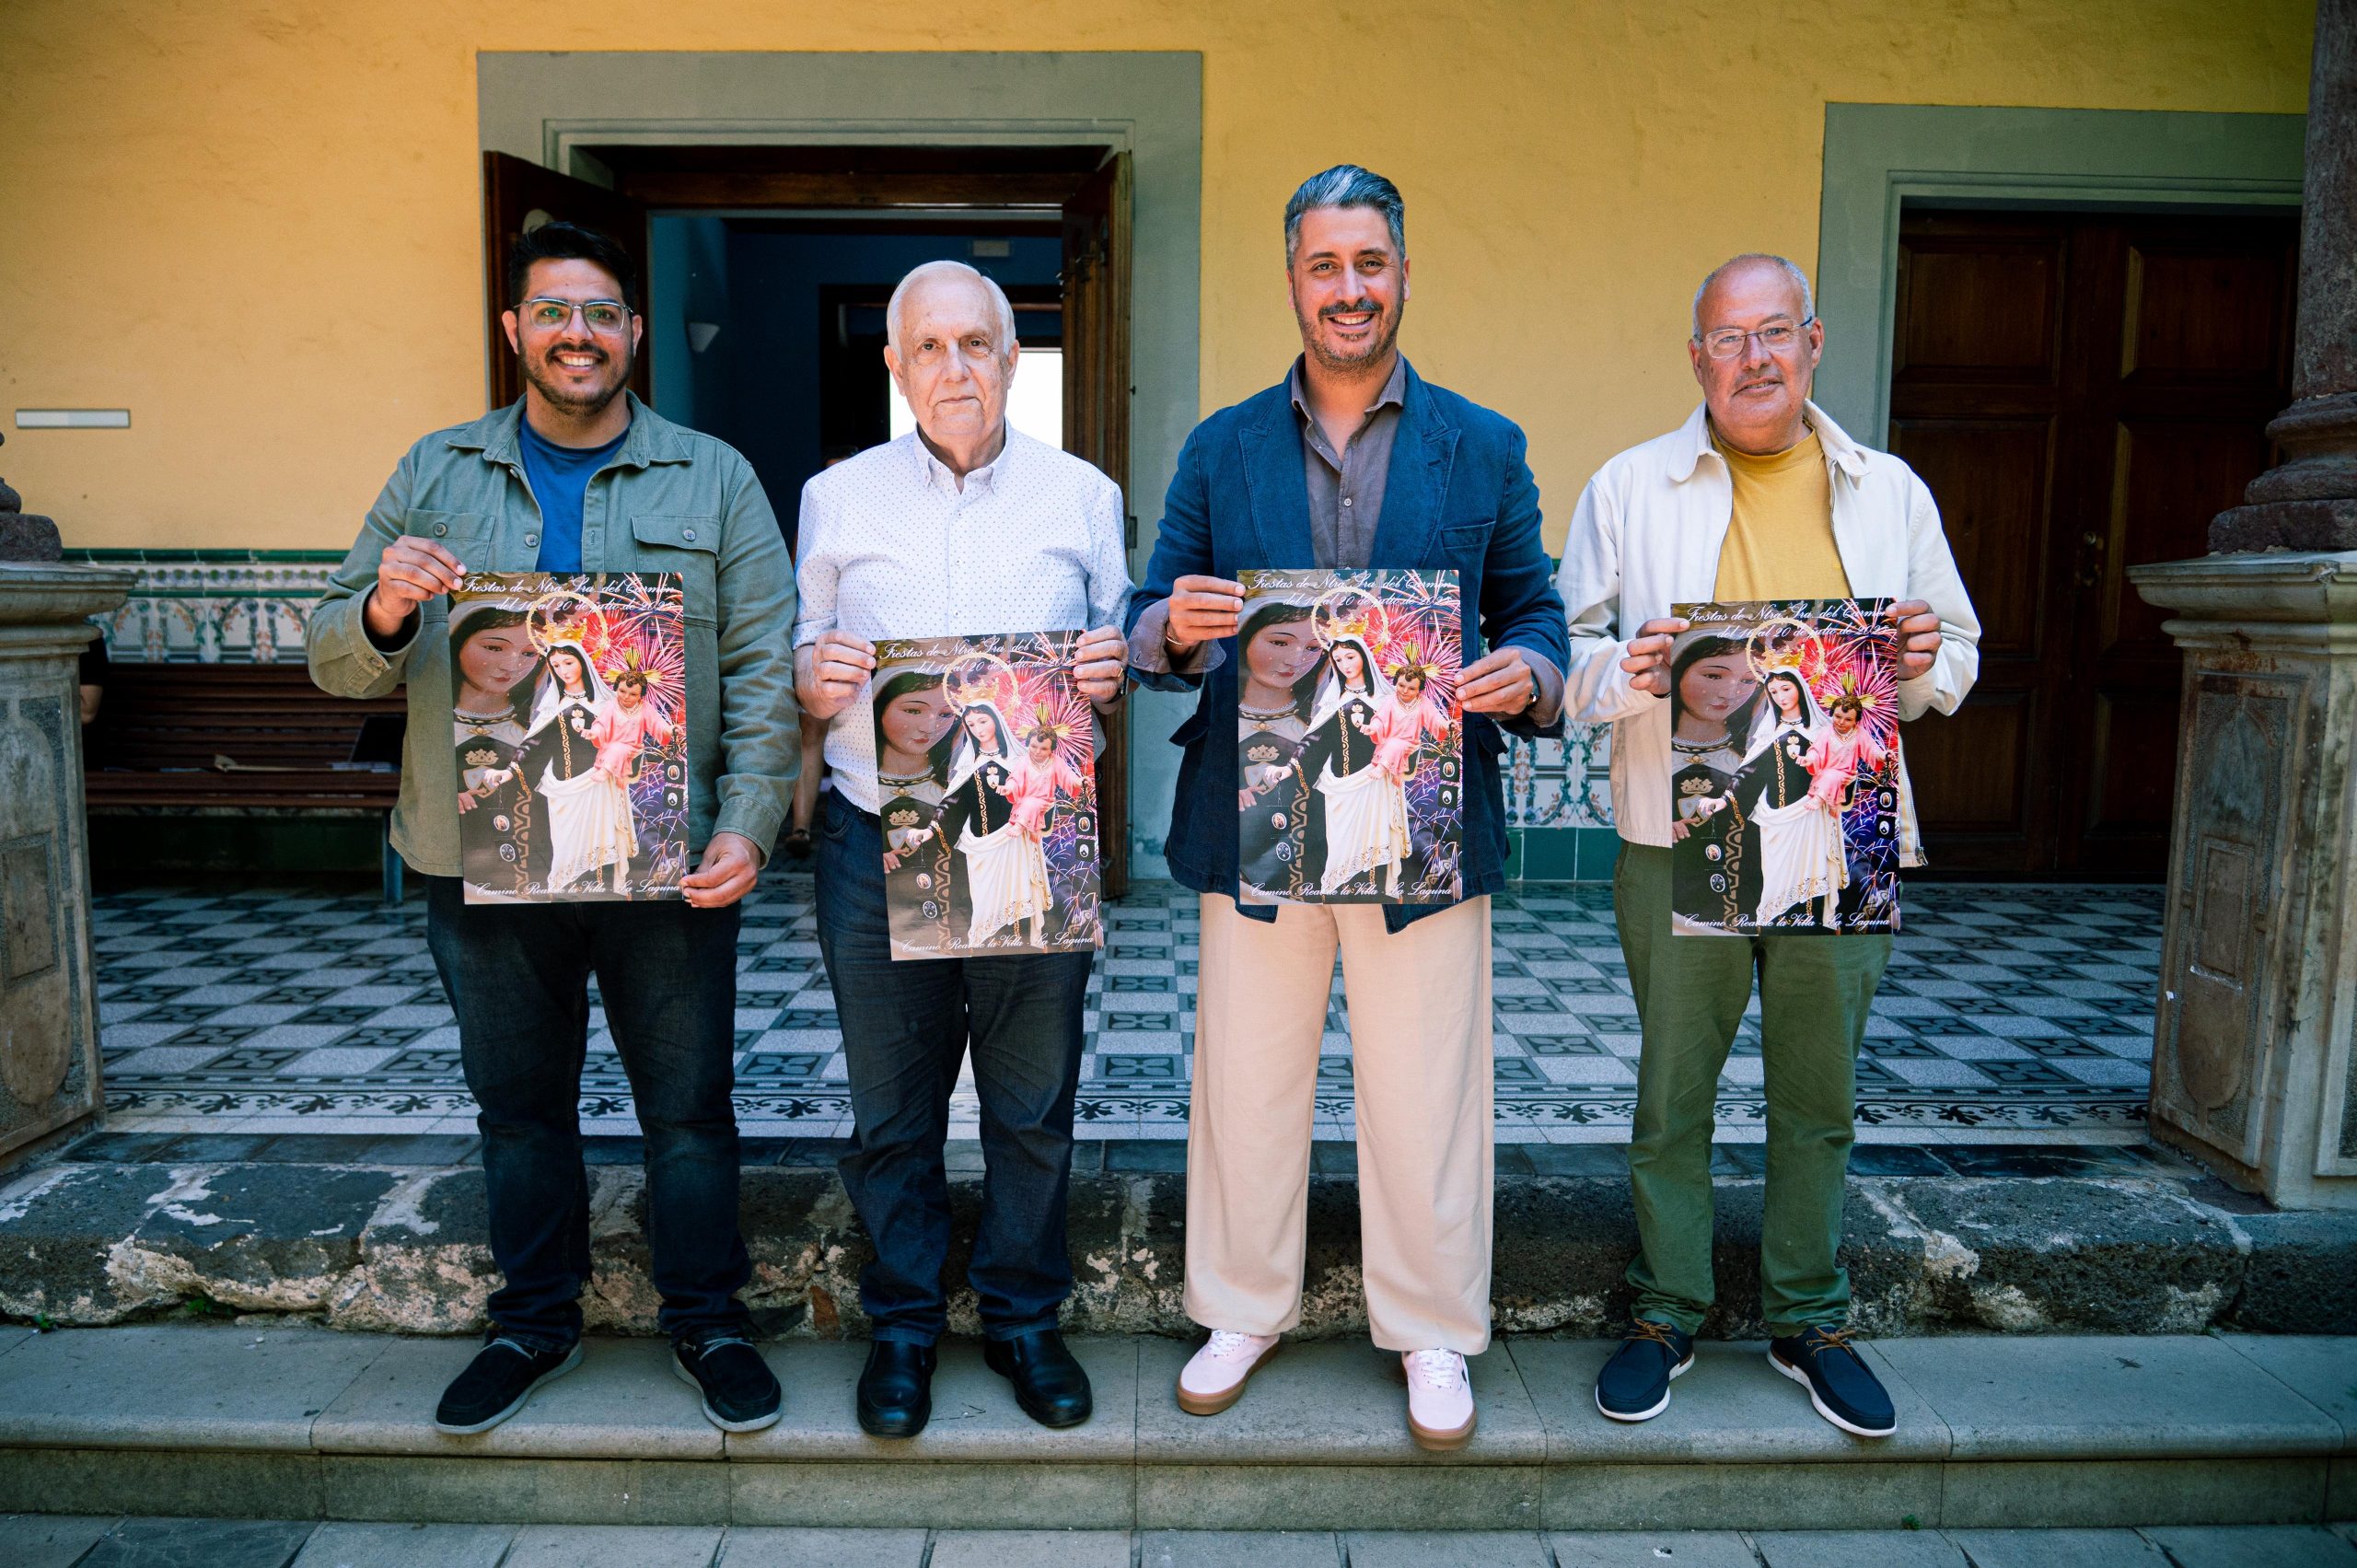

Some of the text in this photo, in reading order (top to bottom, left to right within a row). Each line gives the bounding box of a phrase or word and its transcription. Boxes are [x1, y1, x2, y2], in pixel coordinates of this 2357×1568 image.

[459, 576, 506, 593] Fiestas
[510, 579, 524, 592] de
[602, 579, 624, 593] del
[626, 577, 674, 593] Carmen
[1248, 573, 1293, 589] Fiestas
[1296, 575, 1310, 588] de
[1382, 575, 1404, 588] del
[1404, 574, 1452, 588] Carmen
[495, 598, 516, 610] del
[538, 598, 556, 610] al
[554, 600, 572, 610] 20
[575, 598, 589, 610] de
[622, 598, 635, 610] de
[1283, 593, 1302, 606] del
[1322, 593, 1341, 605] al
[1339, 596, 1356, 606] 20
[1357, 594, 1371, 605] de
[1402, 593, 1415, 605] de
[1688, 606, 1728, 621] Fiestas
[1731, 608, 1745, 621] de
[1819, 605, 1841, 618] del
[1717, 625, 1736, 638] del
[1757, 623, 1776, 637] al
[1774, 627, 1792, 637] 20
[1794, 625, 1807, 636] de
[1840, 622, 1852, 635] de
[879, 643, 923, 659] Fiestas
[926, 644, 940, 656] de
[1011, 638, 1032, 652] del
[914, 661, 933, 674] del
[952, 659, 968, 672] al
[969, 661, 985, 672] 20
[987, 660, 1001, 670] de
[1031, 655, 1044, 668] de
[1049, 656, 1074, 668] 202
[475, 882, 517, 896] Camino
[567, 883, 578, 894] la
[582, 880, 606, 894] Villa
[618, 879, 633, 893] La
[636, 879, 680, 897] Laguna
[1250, 882, 1292, 897] Camino
[1340, 885, 1350, 896] la
[1354, 881, 1378, 896] Villa
[1388, 881, 1405, 895] La
[1408, 881, 1452, 900] Laguna
[1683, 913, 1725, 927] Camino
[1776, 915, 1787, 926] la
[1791, 913, 1816, 927] Villa
[1827, 912, 1842, 926] La
[1845, 912, 1890, 931] Laguna
[900, 939, 940, 952] Camino
[987, 937, 998, 948] la
[1000, 935, 1023, 947] Villa
[1035, 932, 1049, 946] La
[1051, 932, 1094, 949] Laguna
